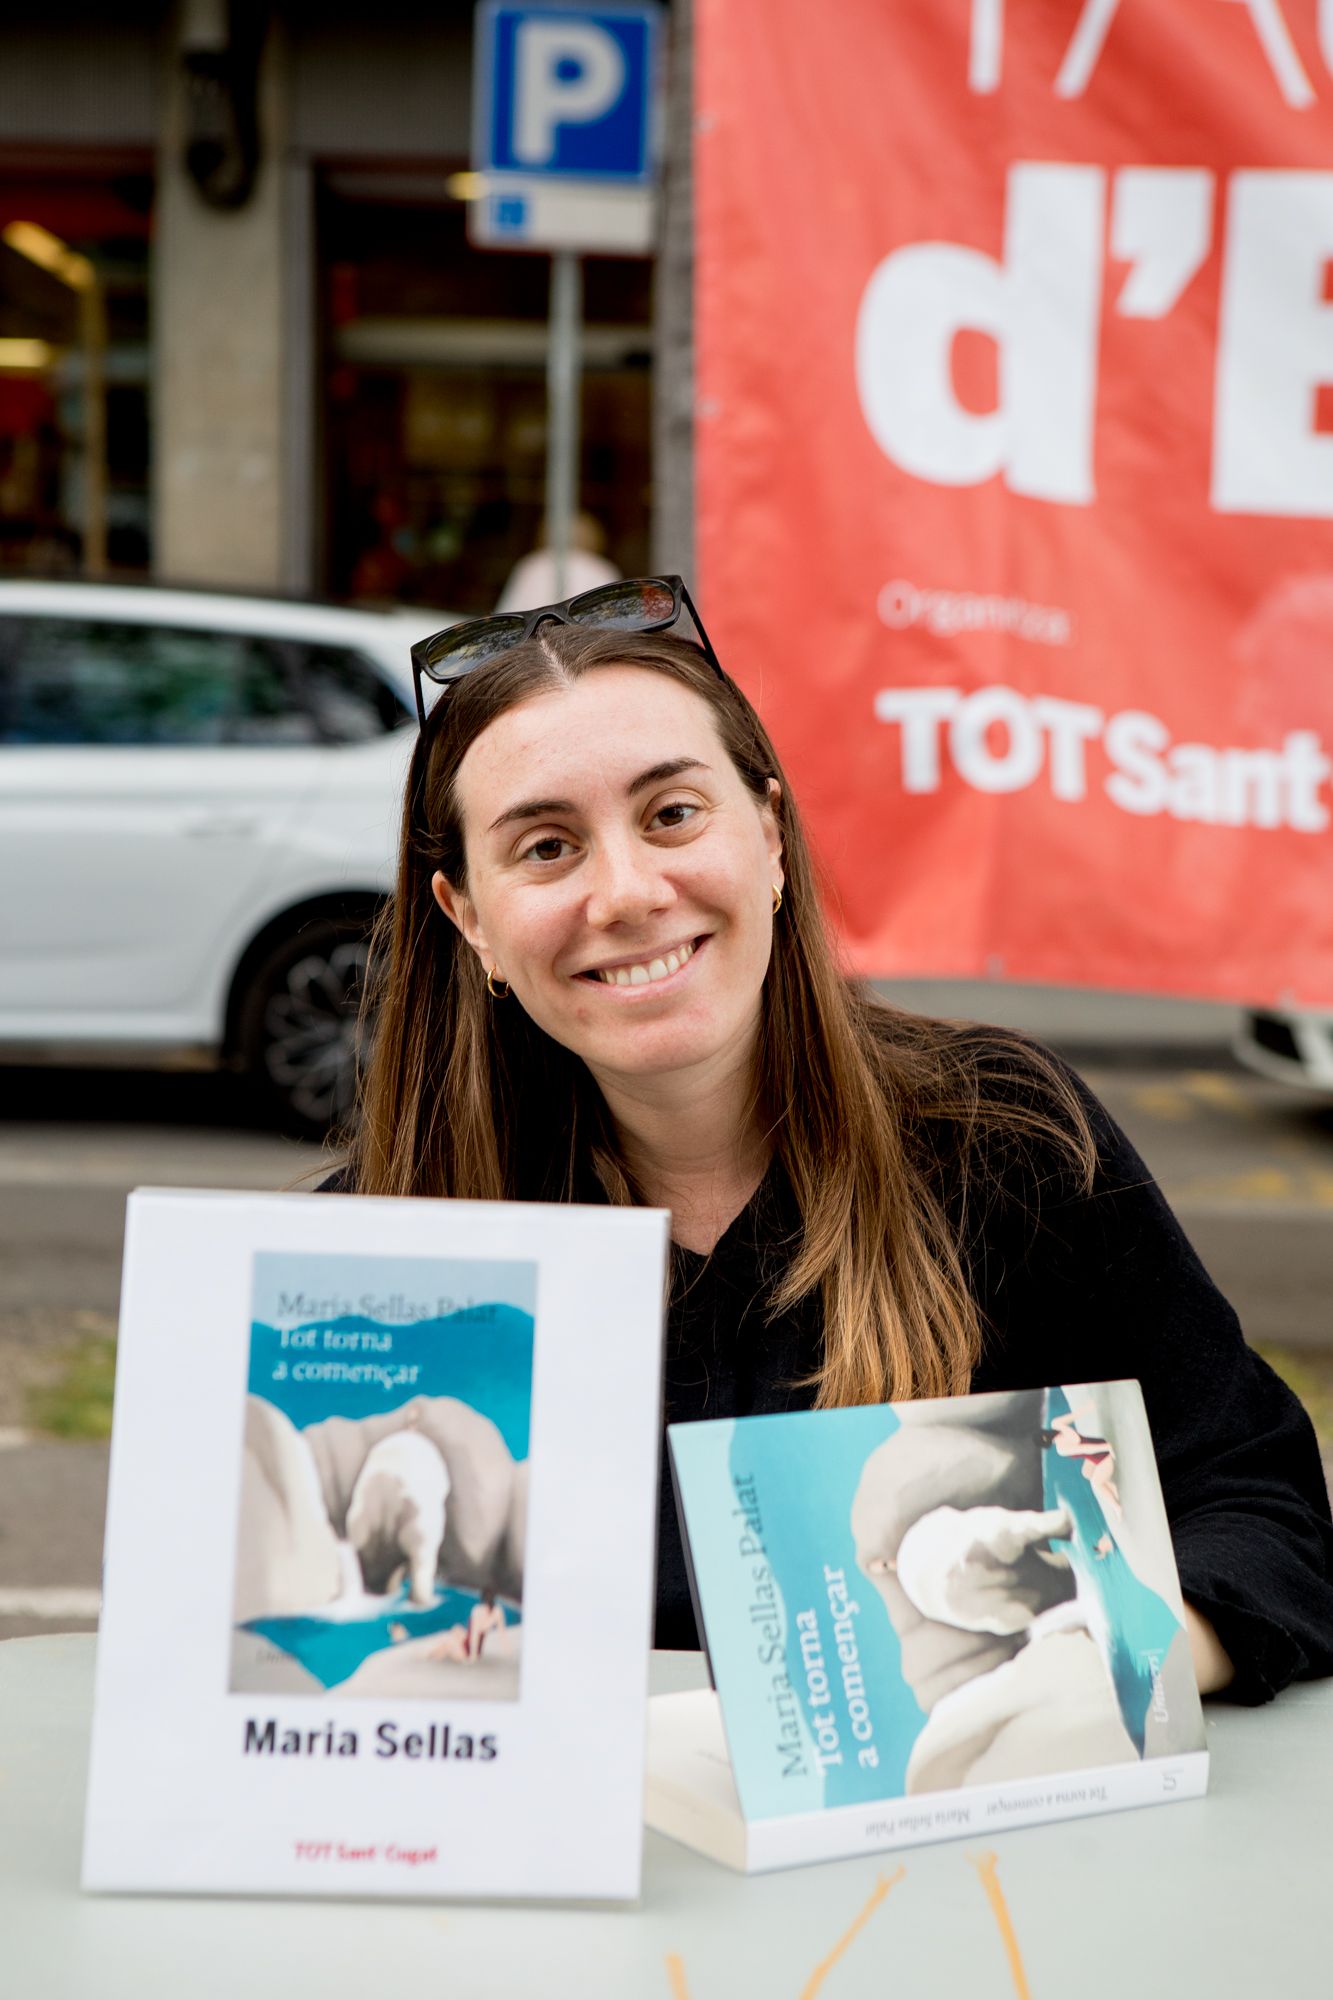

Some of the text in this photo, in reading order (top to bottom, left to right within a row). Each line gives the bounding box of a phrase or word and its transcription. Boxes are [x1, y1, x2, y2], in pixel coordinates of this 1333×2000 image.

[512, 19, 626, 166] P
[277, 1291, 350, 1320] Maria
[358, 1293, 429, 1322] Sellas
[278, 1329, 393, 1352] Tot torna
[271, 1361, 420, 1391] a començar
[732, 1472, 808, 1780] Maria Sellas Palat
[824, 1564, 879, 1769] a començar
[243, 1718, 498, 1761] Maria Sellas
[796, 1607, 844, 1777] Tot torna
